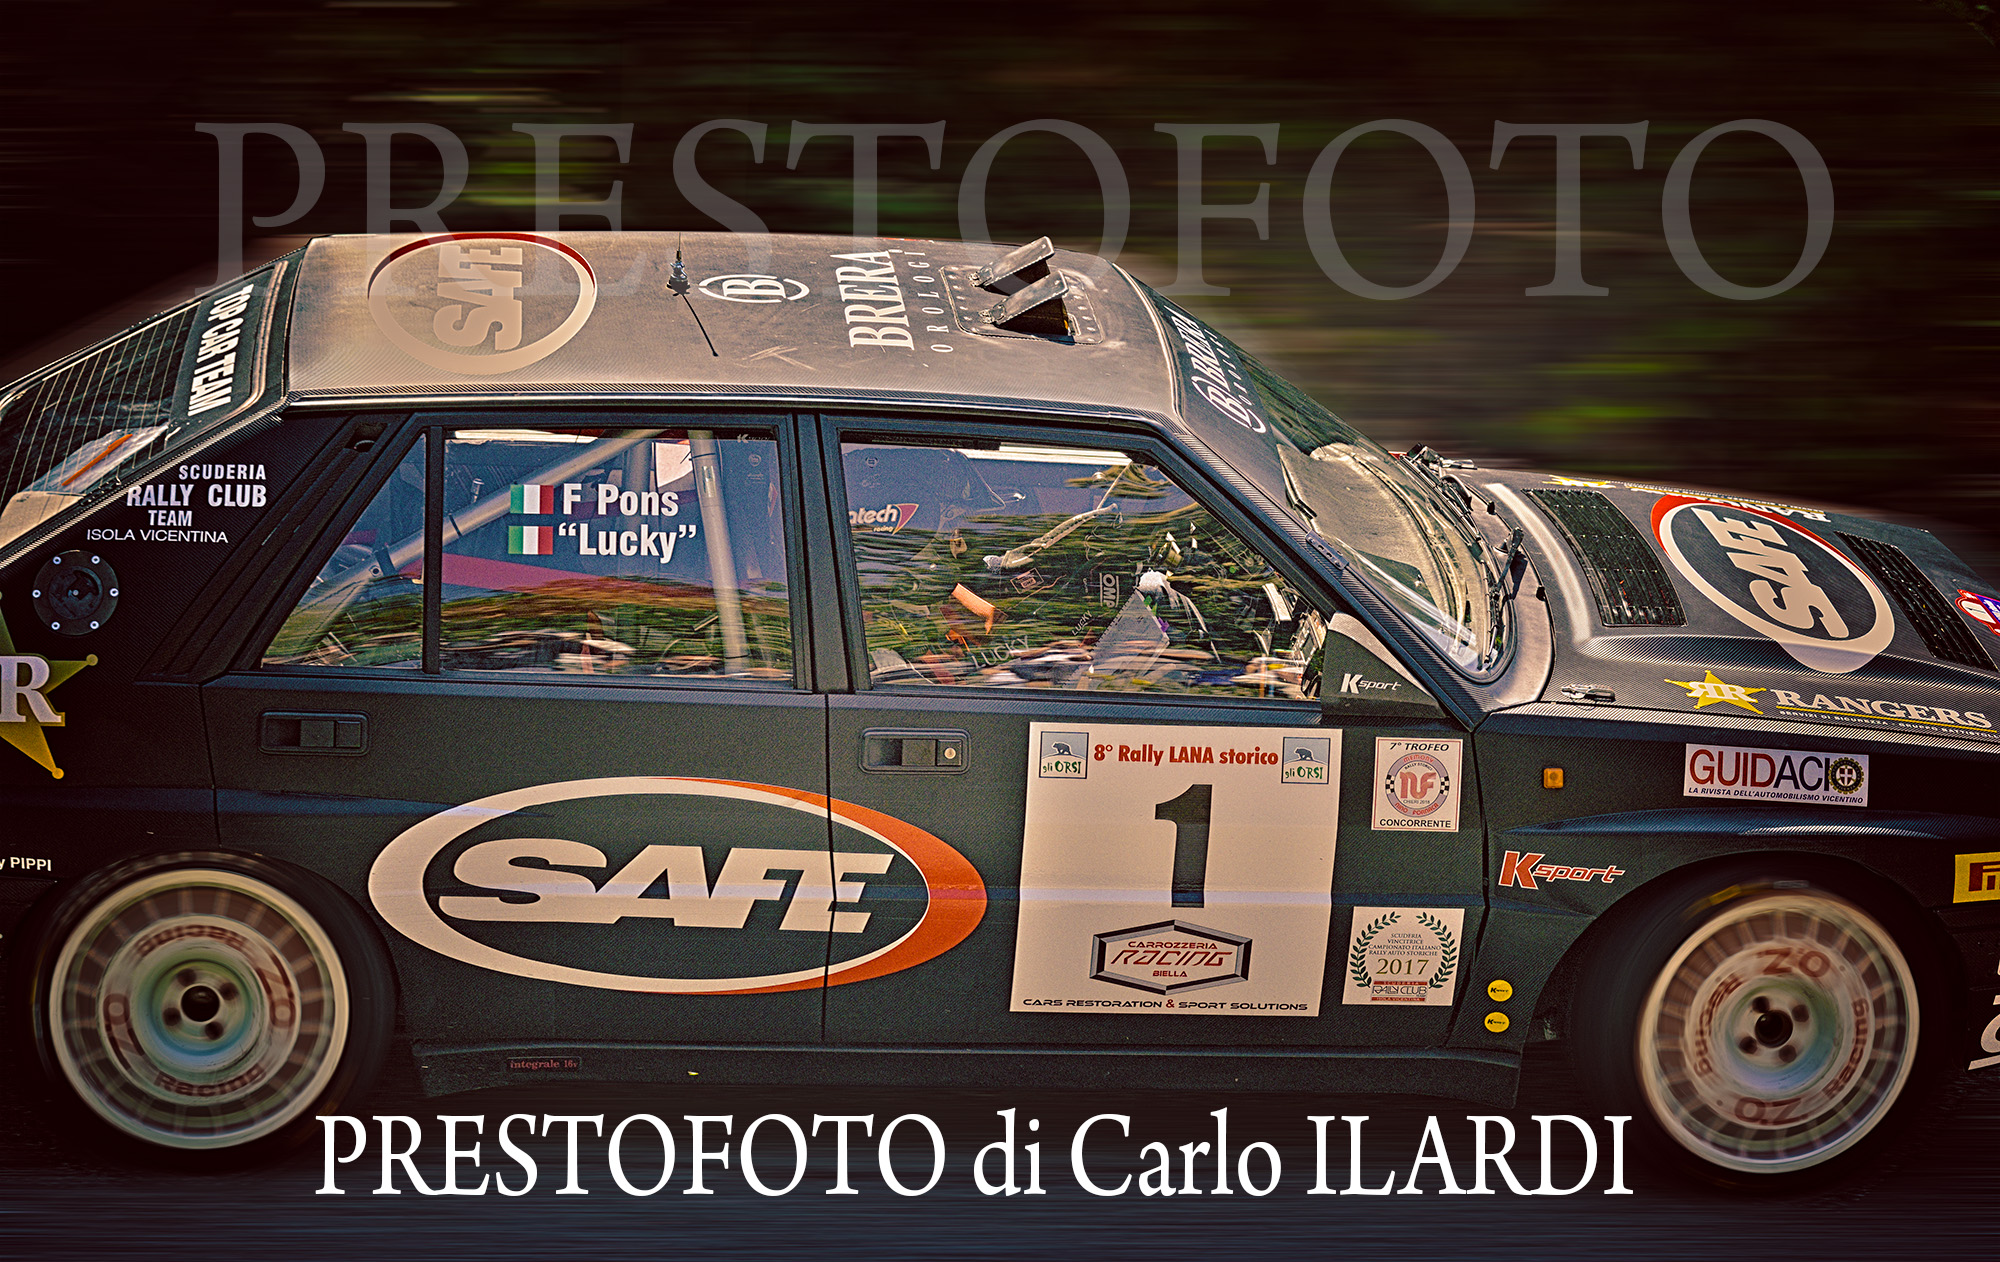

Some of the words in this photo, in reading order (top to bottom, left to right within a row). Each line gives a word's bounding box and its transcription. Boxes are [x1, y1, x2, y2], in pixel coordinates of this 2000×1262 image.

[207, 283, 254, 322] TOP
[433, 243, 523, 351] SAFE
[830, 249, 915, 351] BRERA
[905, 250, 954, 354] OROLOGI
[196, 317, 244, 363] CAR
[187, 351, 236, 417] TEAM
[178, 464, 267, 482] SCUDERIA
[126, 484, 192, 508] RALLY
[207, 484, 267, 508] CLUB
[563, 483, 582, 515] F
[597, 483, 680, 517] Pons
[147, 509, 193, 528] TEAM
[86, 528, 136, 543] ISOLA
[139, 528, 229, 544] VICENTINA
[1691, 507, 1849, 639] SAFE
[1071, 610, 1093, 636] LUCKY
[971, 635, 1030, 669] LUCKY
[1770, 689, 1992, 729] RANGERS
[1093, 743, 1113, 762] 8°
[1118, 743, 1164, 767] Rally
[1169, 745, 1214, 764] LANA
[1219, 746, 1279, 765] storico
[1405, 742, 1449, 752] TROFEO
[1042, 762, 1053, 774] gli
[1055, 760, 1082, 775] ORSI
[1285, 767, 1296, 779] gli
[1297, 766, 1323, 780] ORSI
[1701, 788, 1732, 796] RIVISTA
[1733, 789, 1820, 801] DELL'AUTOMOBILISMO
[1821, 794, 1864, 804] VICENTINO
[1379, 818, 1451, 828] CONCORRENTE
[1155, 783, 1213, 908] 1
[10, 856, 52, 872] PIPPI
[438, 837, 895, 934] SAFE
[1128, 941, 1218, 950] CARROZZERIA
[1152, 970, 1188, 978] BIELLA
[1376, 958, 1429, 975] 2017
[1400, 985, 1428, 995] CLUB
[1066, 999, 1163, 1008] RESTORATION
[1165, 999, 1175, 1008] &
[1178, 1001, 1228, 1010] SPORT
[1230, 1002, 1308, 1011] SOLUTIONS
[510, 1059, 560, 1070] integrale
[564, 1059, 578, 1068] 16v
